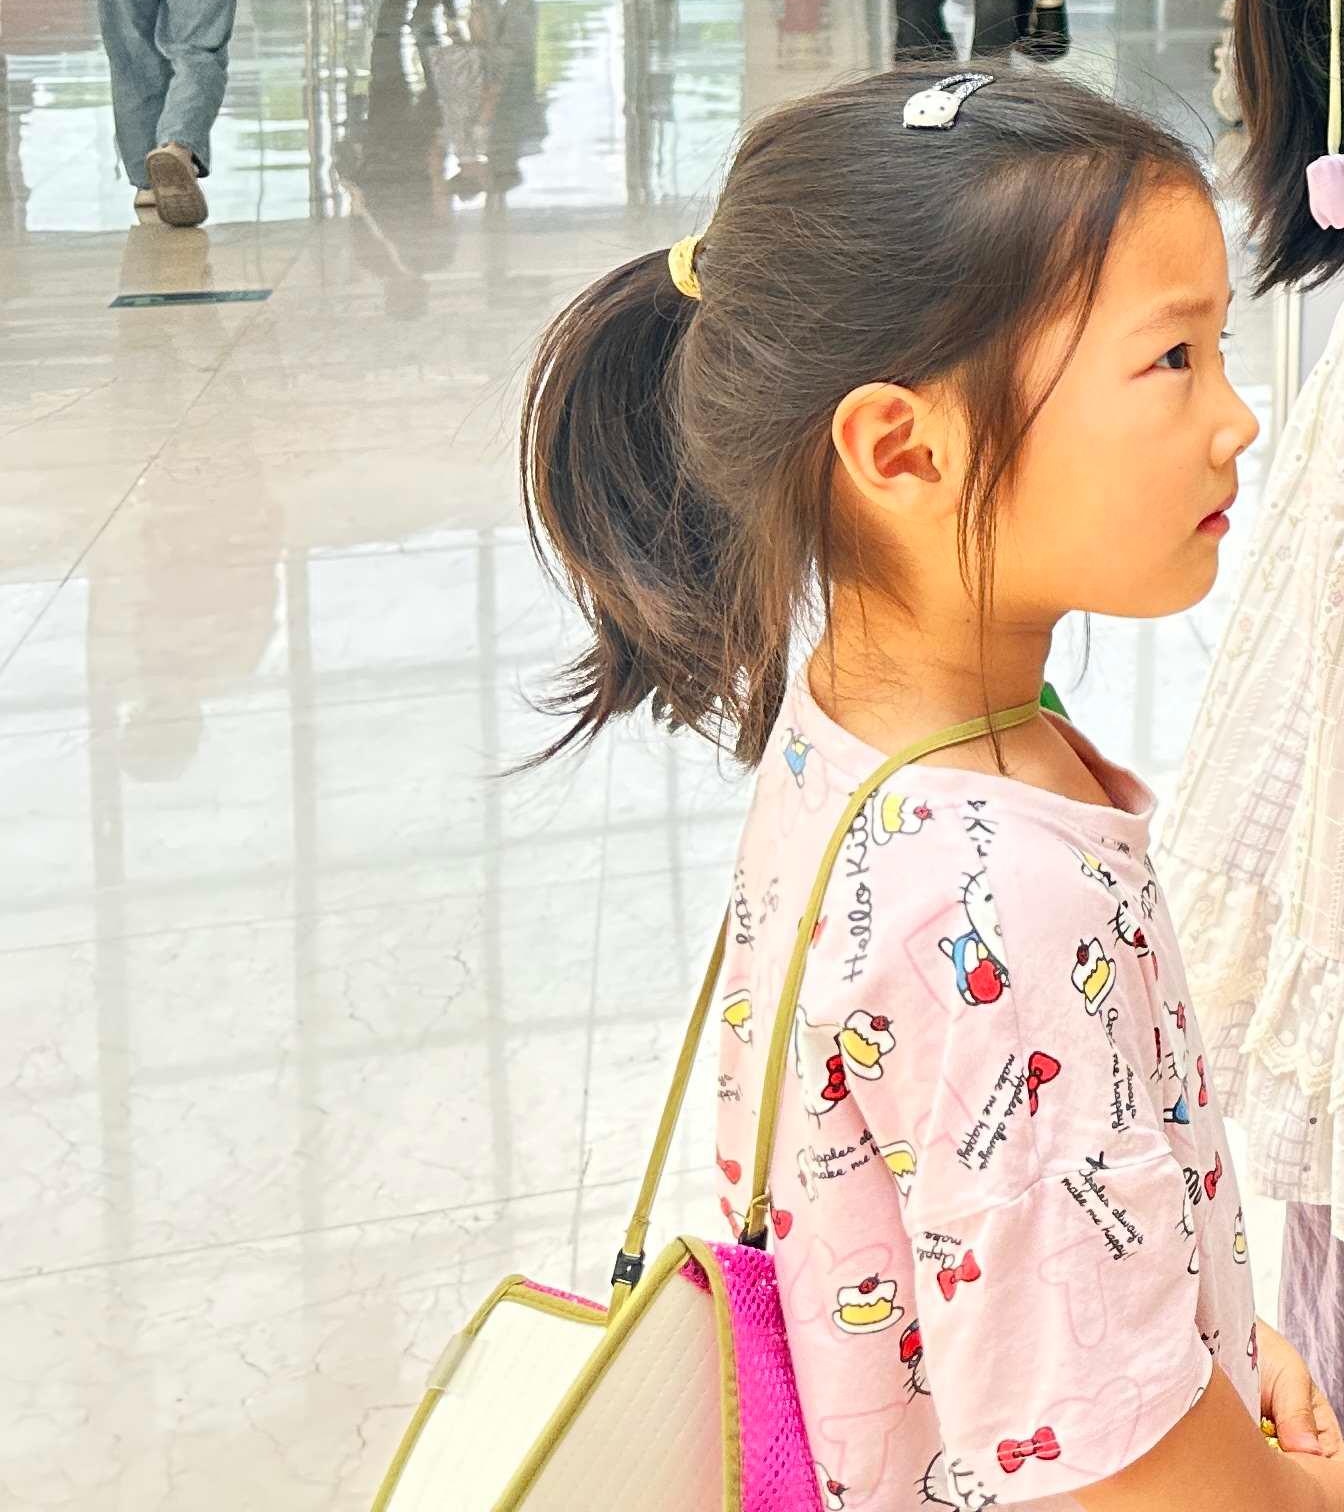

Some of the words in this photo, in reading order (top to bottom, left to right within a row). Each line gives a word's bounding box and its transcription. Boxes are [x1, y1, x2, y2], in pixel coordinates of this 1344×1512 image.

[842, 882, 873, 982] Hello
[956, 1120, 991, 1170] happy!
[979, 1122, 1006, 1171] always
[1061, 1177, 1088, 1207] make
[1086, 1208, 1103, 1226] me
[1101, 1225, 1138, 1261] happy!
[1111, 1208, 1144, 1245] always
